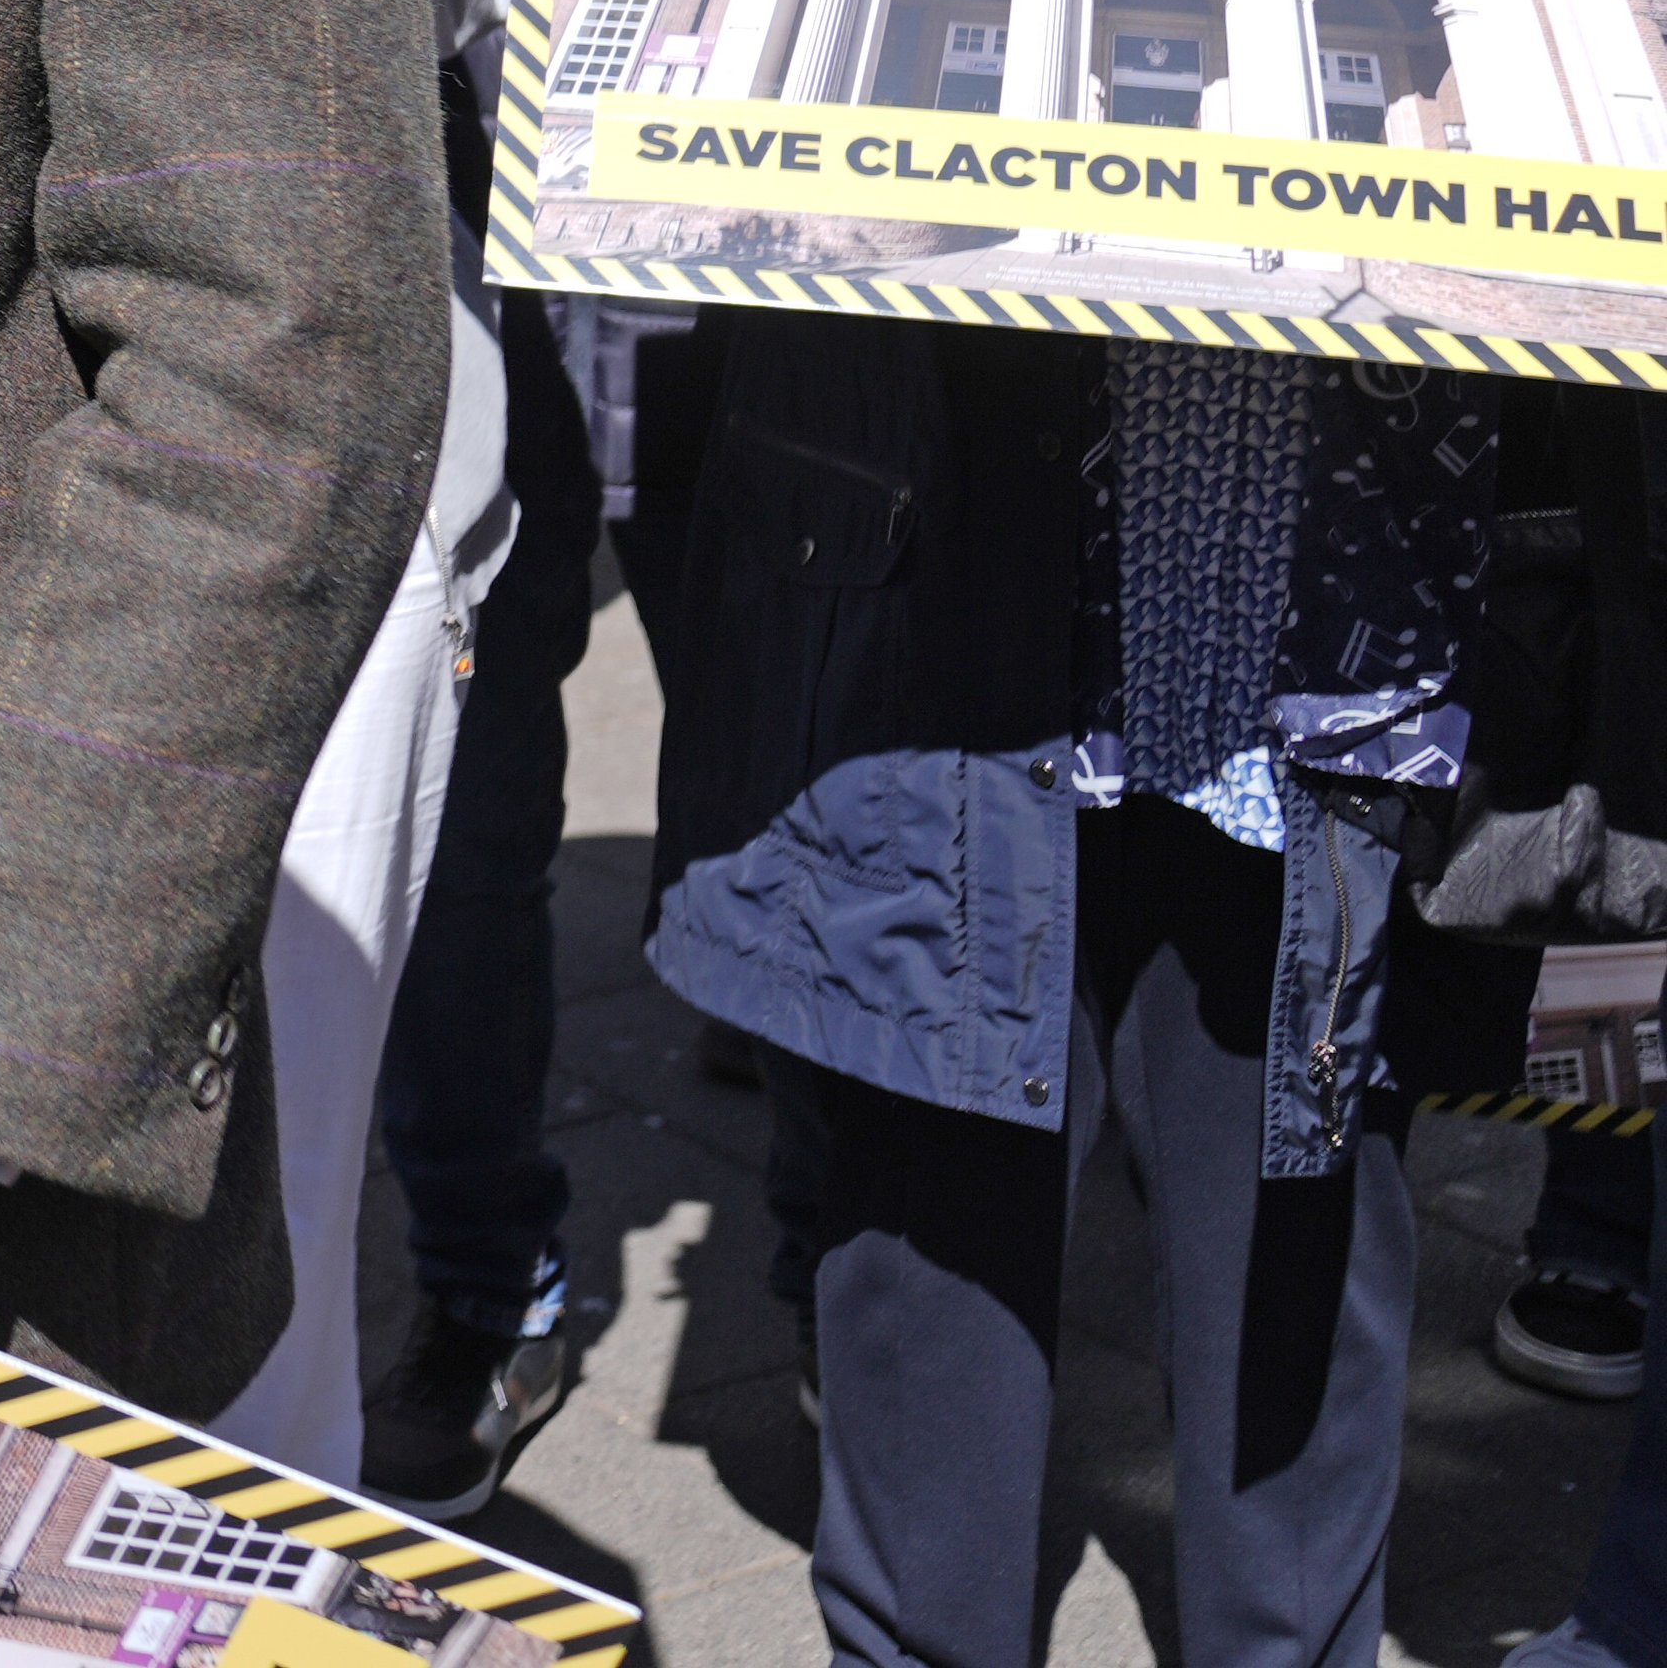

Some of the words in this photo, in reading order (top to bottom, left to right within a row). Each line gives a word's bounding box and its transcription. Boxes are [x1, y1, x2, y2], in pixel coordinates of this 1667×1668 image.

[636, 123, 821, 171] SAVE
[845, 137, 1197, 200] CLACTON
[1223, 164, 1466, 225] TOWN
[1495, 186, 1667, 243] HAL
